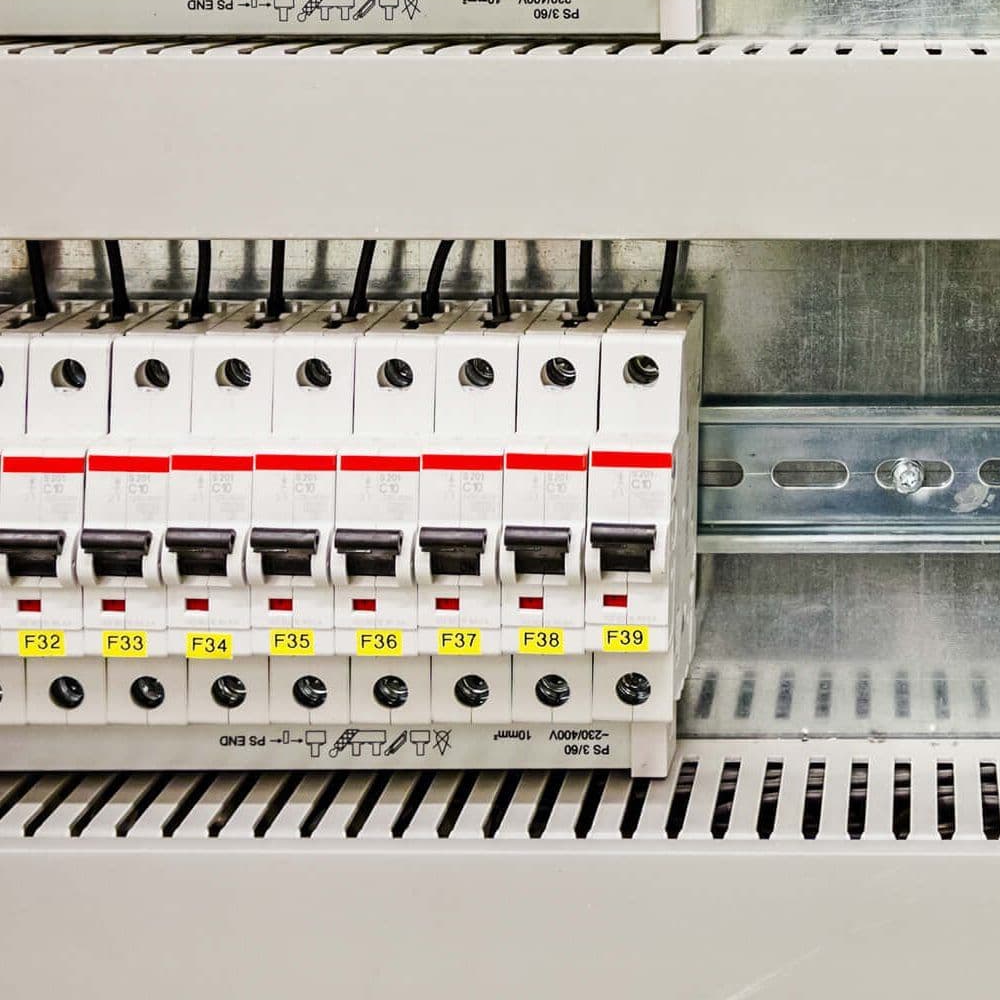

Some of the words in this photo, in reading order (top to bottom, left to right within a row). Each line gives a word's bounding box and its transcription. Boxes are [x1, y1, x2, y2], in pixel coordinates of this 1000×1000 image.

[188, 0, 213, 9] END
[217, 0, 233, 10] PS
[534, 9, 559, 19] 3/60
[563, 9, 579, 19] PS
[25, 635, 61, 650] F32
[108, 636, 144, 651] F33
[275, 634, 311, 649] F35
[361, 635, 398, 650] F36
[442, 633, 477, 648] F37
[524, 633, 560, 648] F38
[607, 631, 644, 646] F39
[192, 638, 228, 653] F34
[220, 736, 245, 746] END
[249, 736, 265, 746] PS
[565, 745, 590, 755] 3/60
[594, 745, 609, 755] PS
